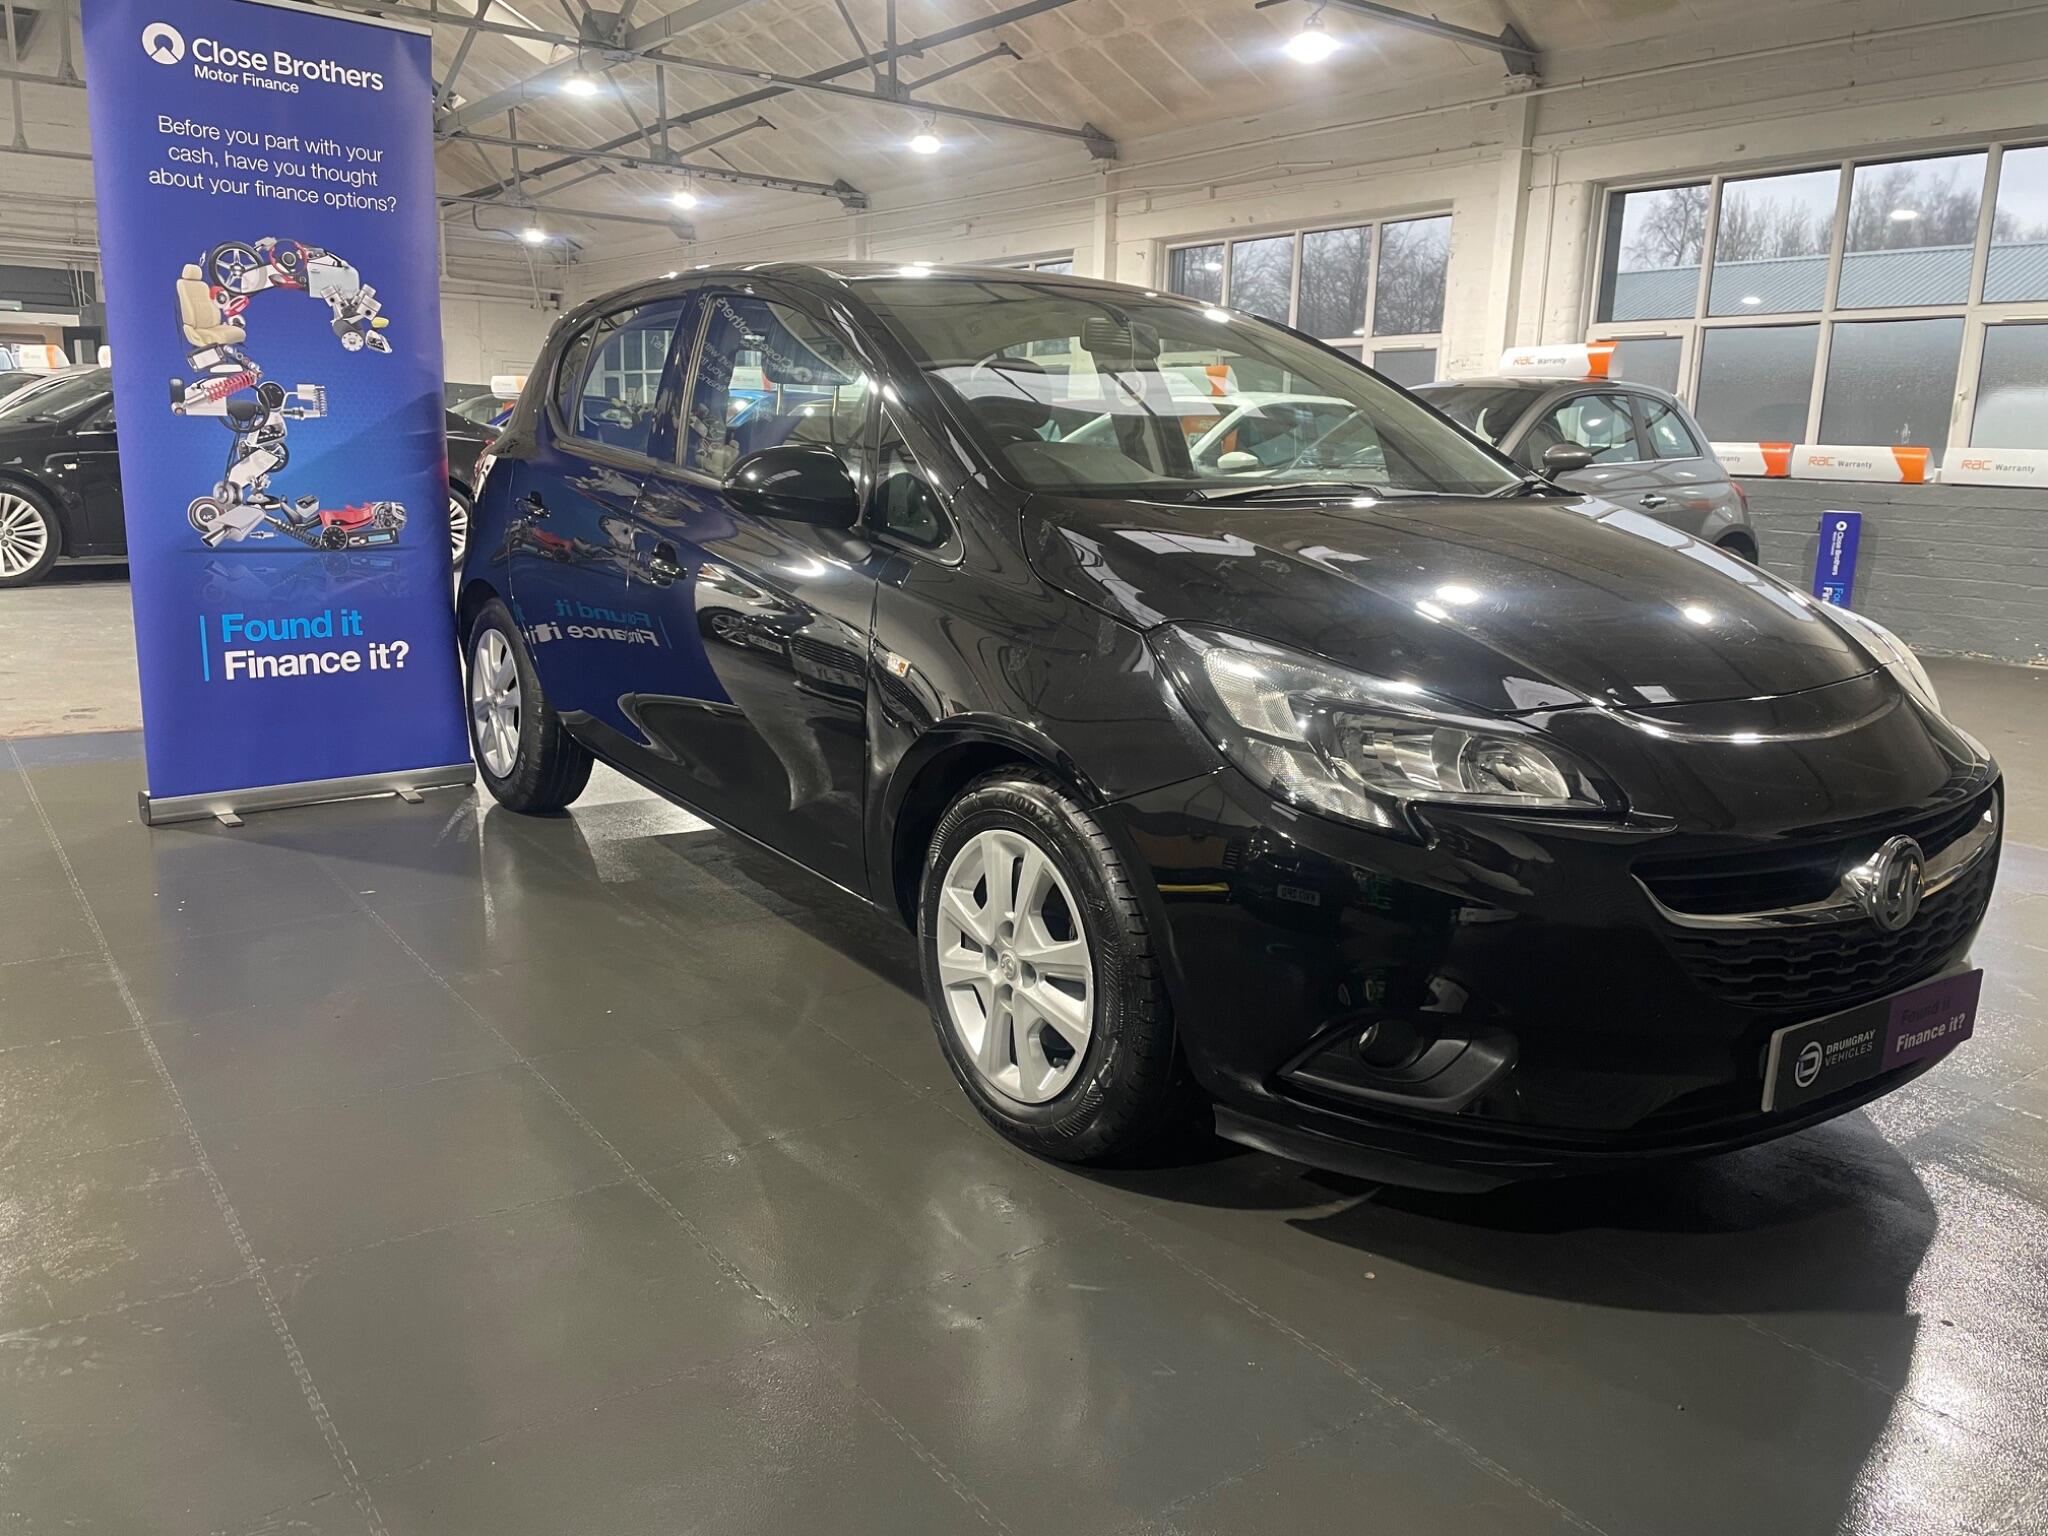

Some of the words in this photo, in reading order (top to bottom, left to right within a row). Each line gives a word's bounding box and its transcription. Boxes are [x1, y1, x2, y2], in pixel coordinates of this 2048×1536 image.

[192, 38, 268, 71] Close
[273, 51, 384, 91] Brothers
[194, 64, 239, 84] Motor
[243, 72, 300, 94] Finance
[157, 115, 220, 140] Before
[225, 128, 259, 147] you
[265, 134, 300, 152] part
[305, 140, 341, 158] with
[345, 147, 384, 164] your
[168, 145, 219, 169] cash,
[224, 150, 268, 172] have
[273, 160, 305, 178] you
[310, 163, 378, 187] thought
[149, 168, 204, 190] about
[208, 176, 250, 195] your
[254, 180, 319, 204] finance
[323, 190, 397, 213] options?
[1838, 460, 1872, 469] Warranty
[1995, 464, 2035, 473] Warranty
[1832, 549, 1842, 576] Brothers
[221, 609, 332, 643] Found
[341, 608, 363, 636] it
[224, 650, 361, 680] Finance
[369, 640, 409, 671] it?
[1826, 1029, 1877, 1055] DRUMGRAY
[1896, 1023, 1946, 1053] Finance
[1949, 1012, 1967, 1033] it?
[1824, 1041, 1873, 1066] VEHICLES
